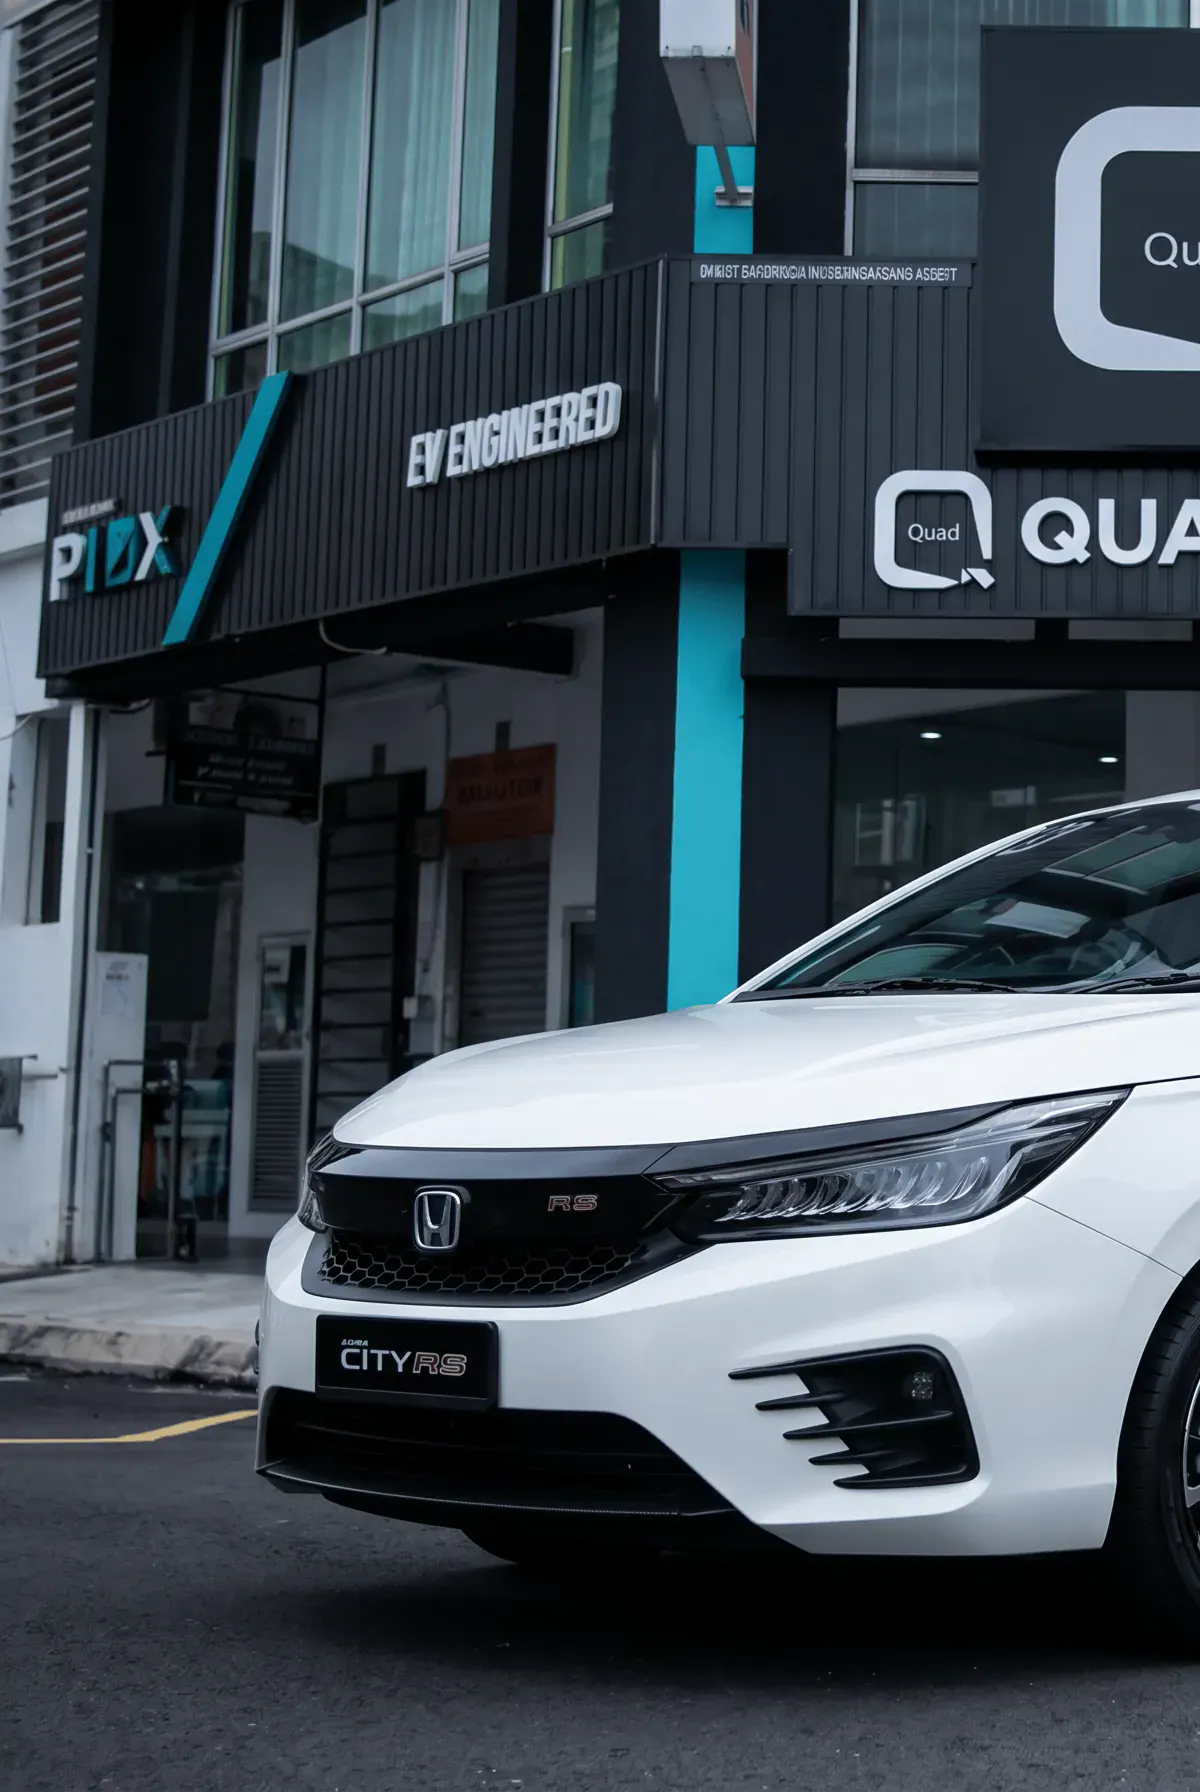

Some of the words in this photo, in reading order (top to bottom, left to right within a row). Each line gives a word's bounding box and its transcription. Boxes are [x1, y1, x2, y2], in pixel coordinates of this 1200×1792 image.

[406, 429, 448, 488] EV
[446, 381, 622, 478] ENGINEERED
[908, 522, 960, 542] Quad
[547, 1194, 598, 1212] RS
[340, 1347, 412, 1373] CITY
[412, 1351, 468, 1377] RS
